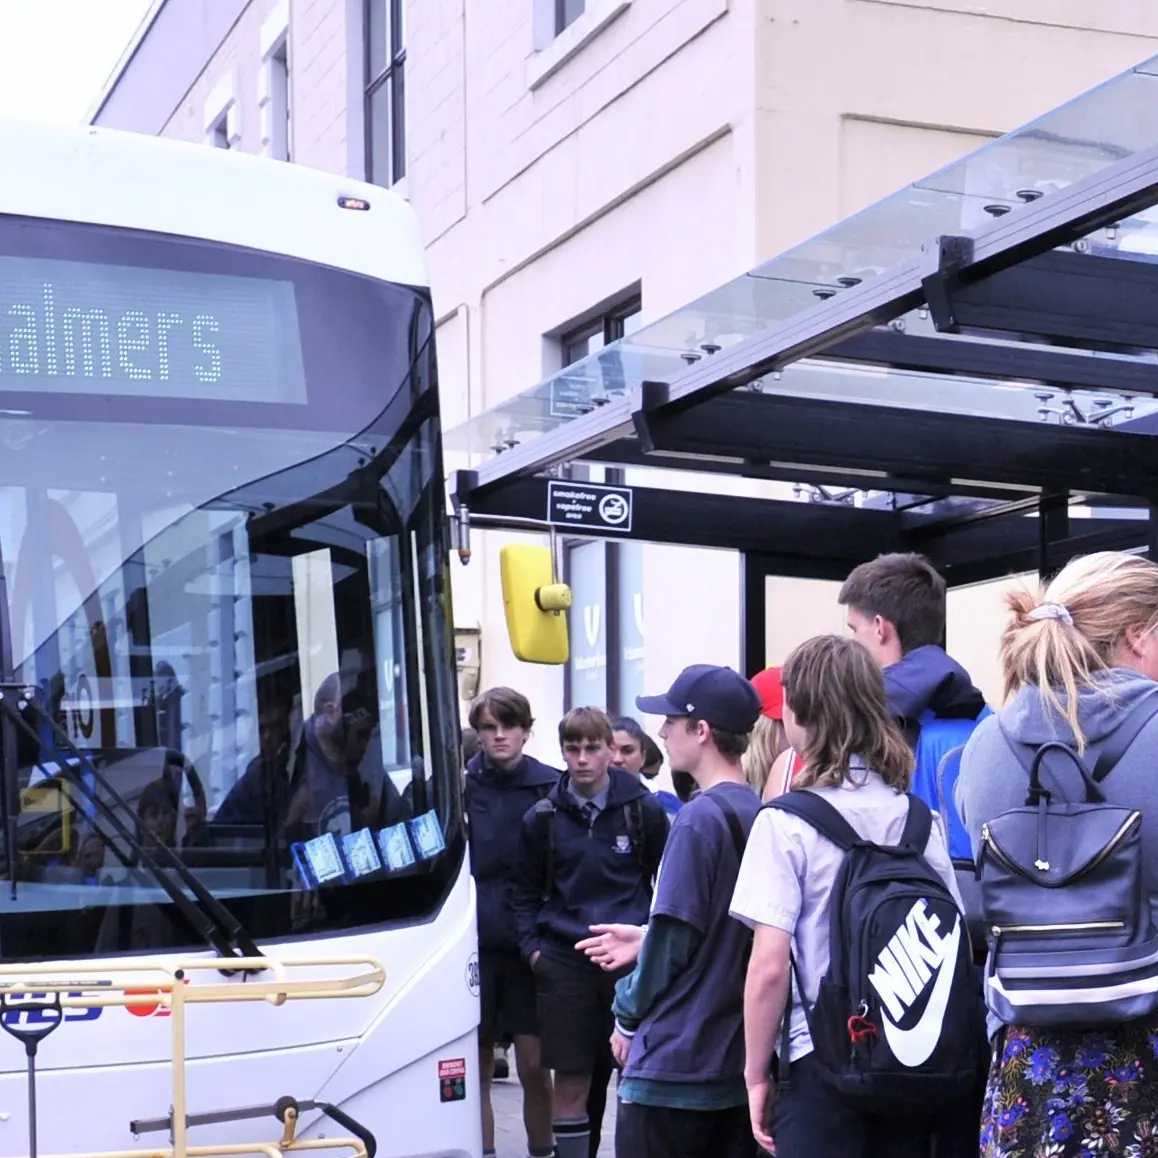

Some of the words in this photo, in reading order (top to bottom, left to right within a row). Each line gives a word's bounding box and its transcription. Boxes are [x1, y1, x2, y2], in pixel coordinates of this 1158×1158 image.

[0, 281, 221, 383] almers
[553, 490, 597, 501] smokefree
[867, 897, 952, 1023] NIKE
